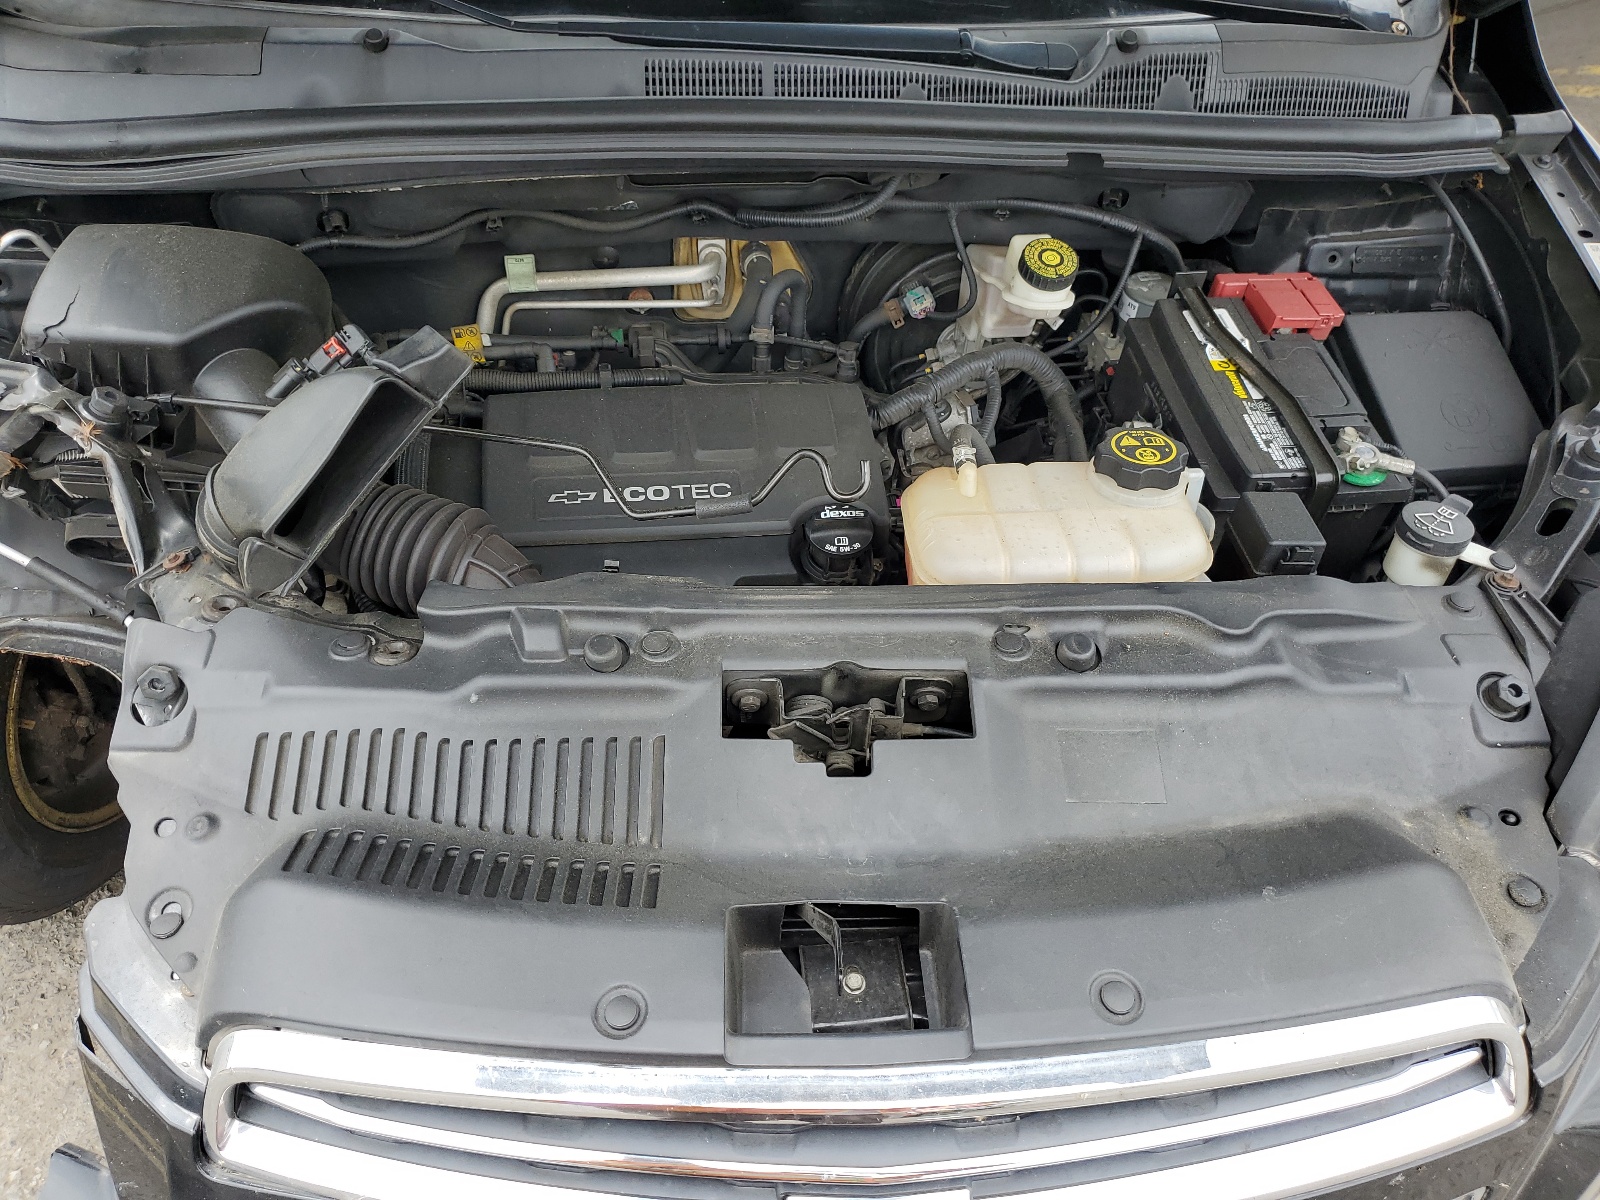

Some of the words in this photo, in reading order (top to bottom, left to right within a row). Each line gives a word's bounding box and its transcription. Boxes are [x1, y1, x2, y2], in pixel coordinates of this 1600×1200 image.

[820, 509, 865, 518] dexos
[825, 543, 837, 552] SAE
[840, 542, 861, 553] 5W-30
